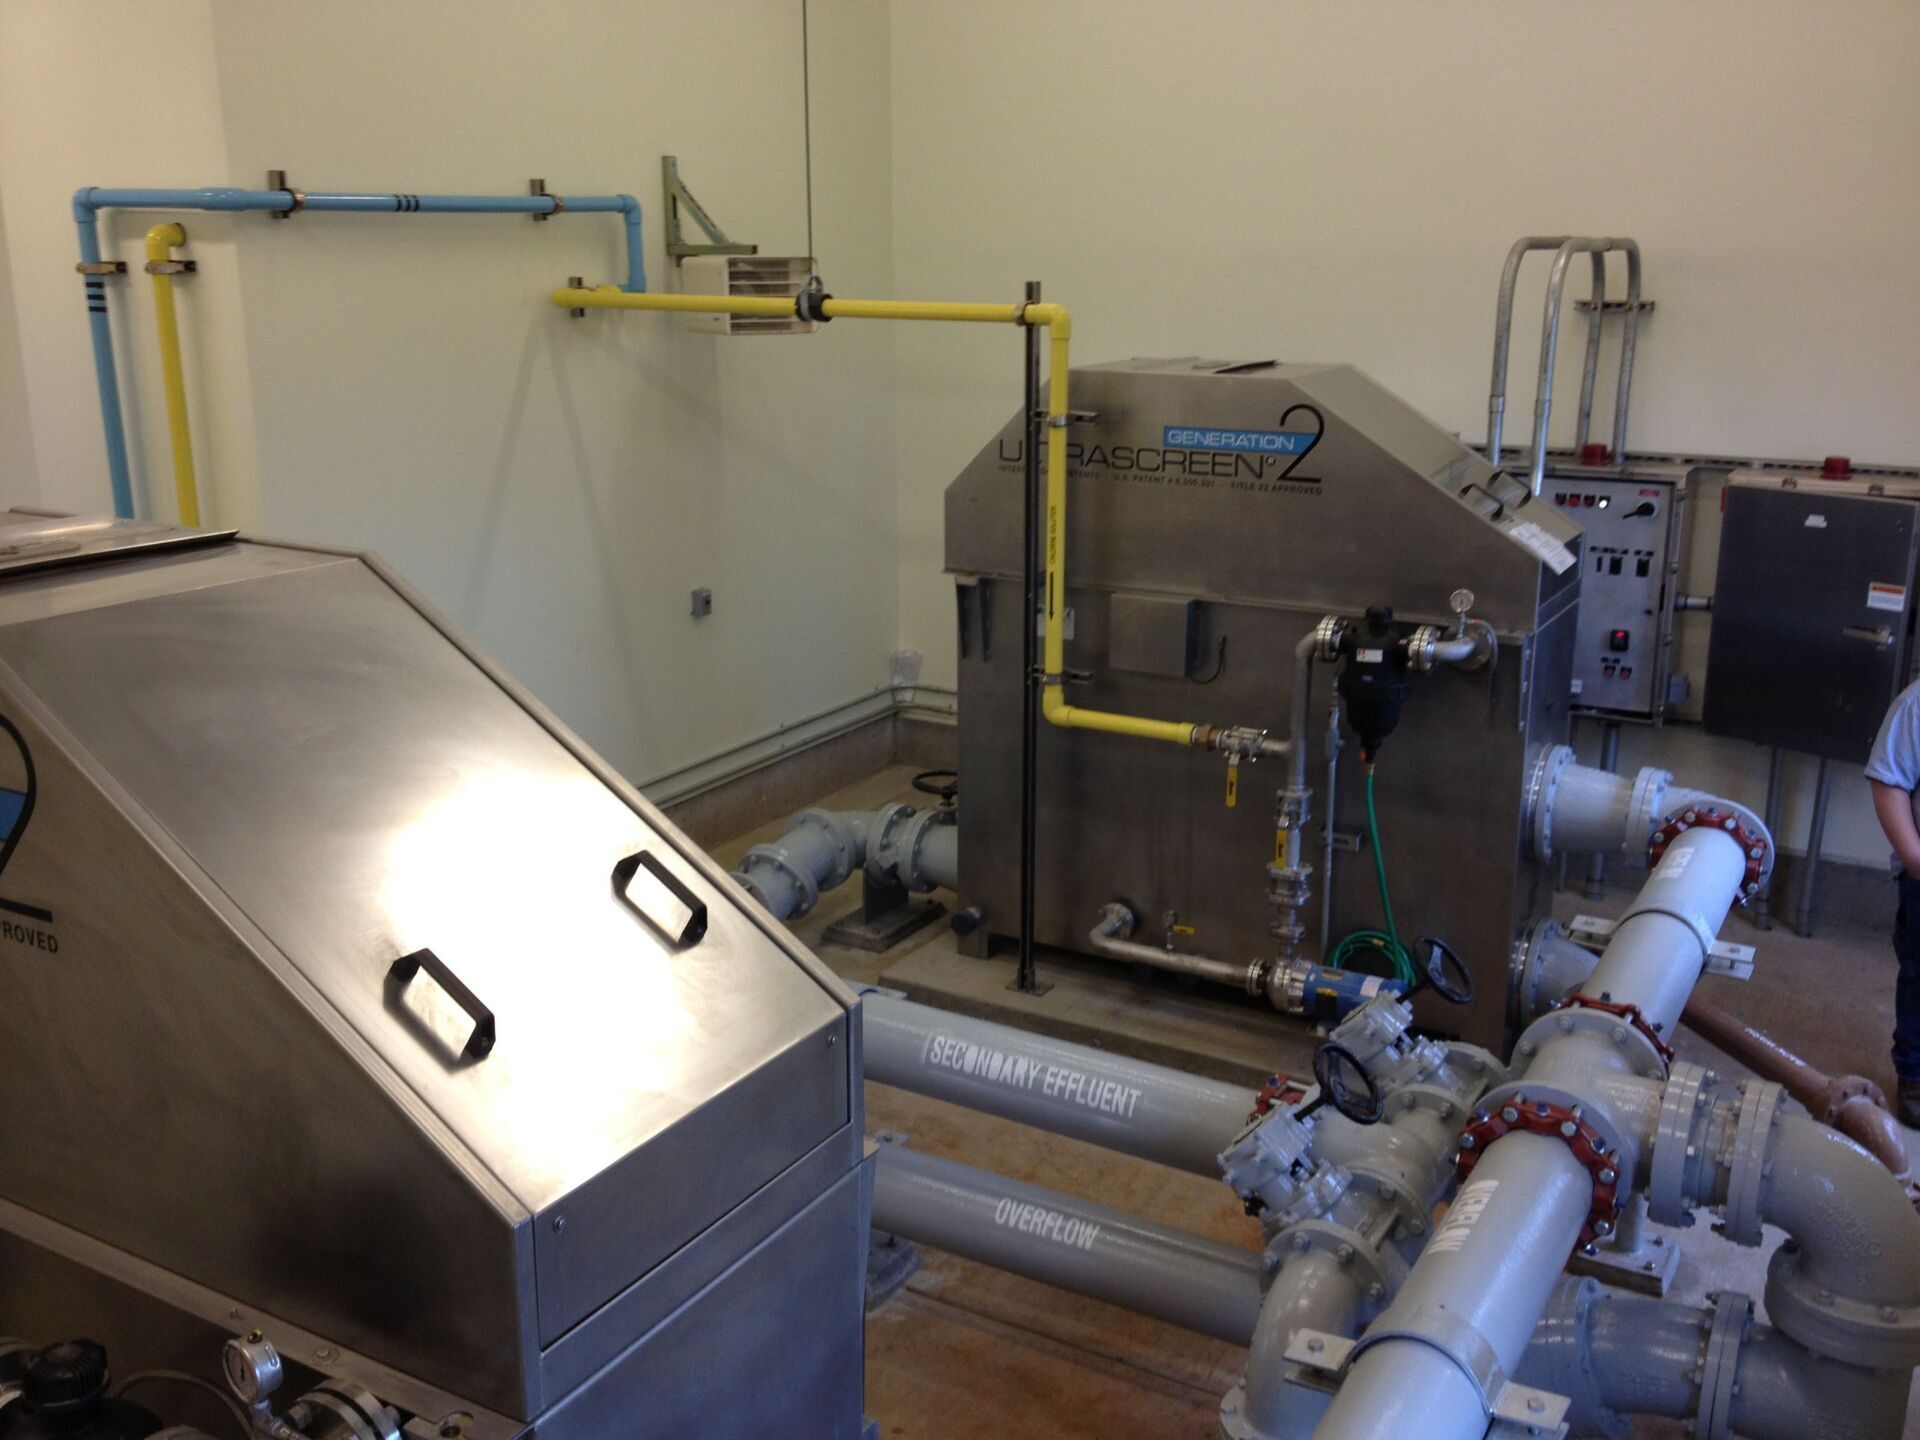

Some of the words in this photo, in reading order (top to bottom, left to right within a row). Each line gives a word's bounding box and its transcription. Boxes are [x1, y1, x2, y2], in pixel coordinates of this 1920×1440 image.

[1000, 438, 1264, 479] URASCREEN
[1167, 429, 1295, 451] GENERATION
[1278, 403, 1325, 484] 2
[1134, 474, 1165, 484] PATENT
[1231, 481, 1255, 491] TITLE
[1271, 484, 1323, 496] APPROVED
[1, 920, 58, 953] ROVED
[930, 1036, 1041, 1090] SECONDARY
[1043, 1068, 1142, 1118] EFFLUENT
[994, 1197, 1100, 1251] OVERFLOW
